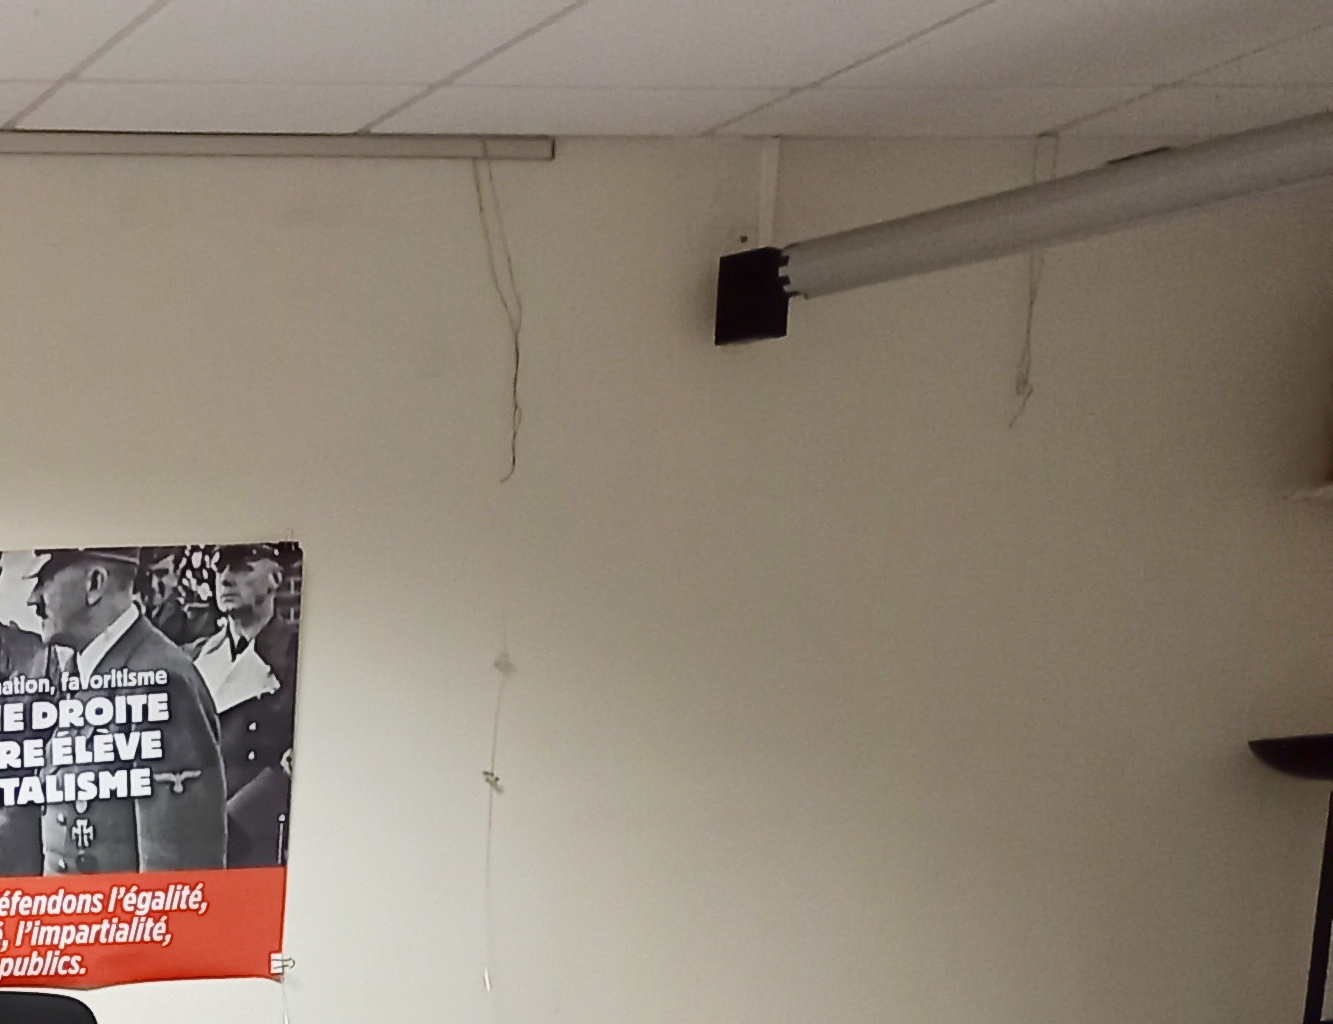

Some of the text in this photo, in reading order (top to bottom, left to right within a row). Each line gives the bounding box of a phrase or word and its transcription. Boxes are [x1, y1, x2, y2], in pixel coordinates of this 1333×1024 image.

[61, 669, 167, 692] favoritisme
[32, 693, 169, 729] DROITE
[52, 729, 163, 766] ÉLÈVE
[108, 883, 208, 915] l'égalité,
[15, 916, 172, 949] l'impartialité,
